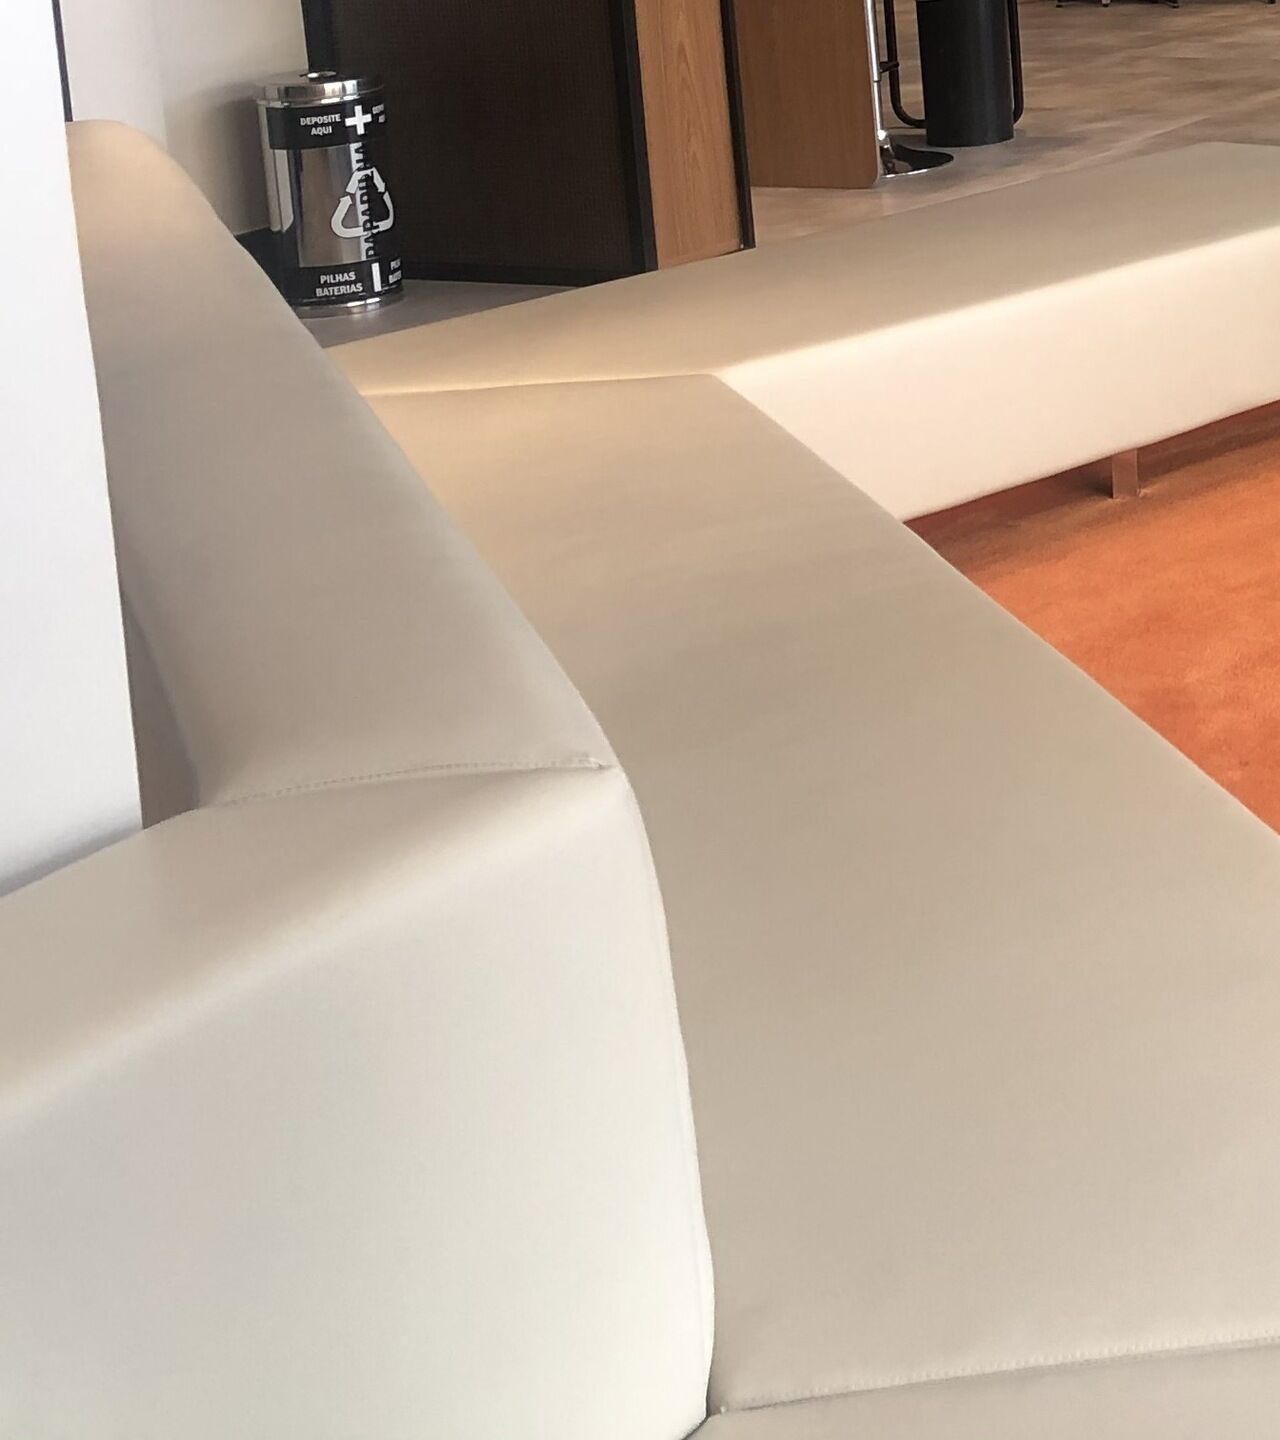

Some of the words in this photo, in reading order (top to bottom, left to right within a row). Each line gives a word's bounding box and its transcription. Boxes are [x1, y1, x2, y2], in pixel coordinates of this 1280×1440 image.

[300, 113, 342, 126] DEPOSITE
[310, 125, 333, 136] AQUI
[320, 271, 356, 284] PILHAS
[315, 283, 364, 297] BATERIAS
